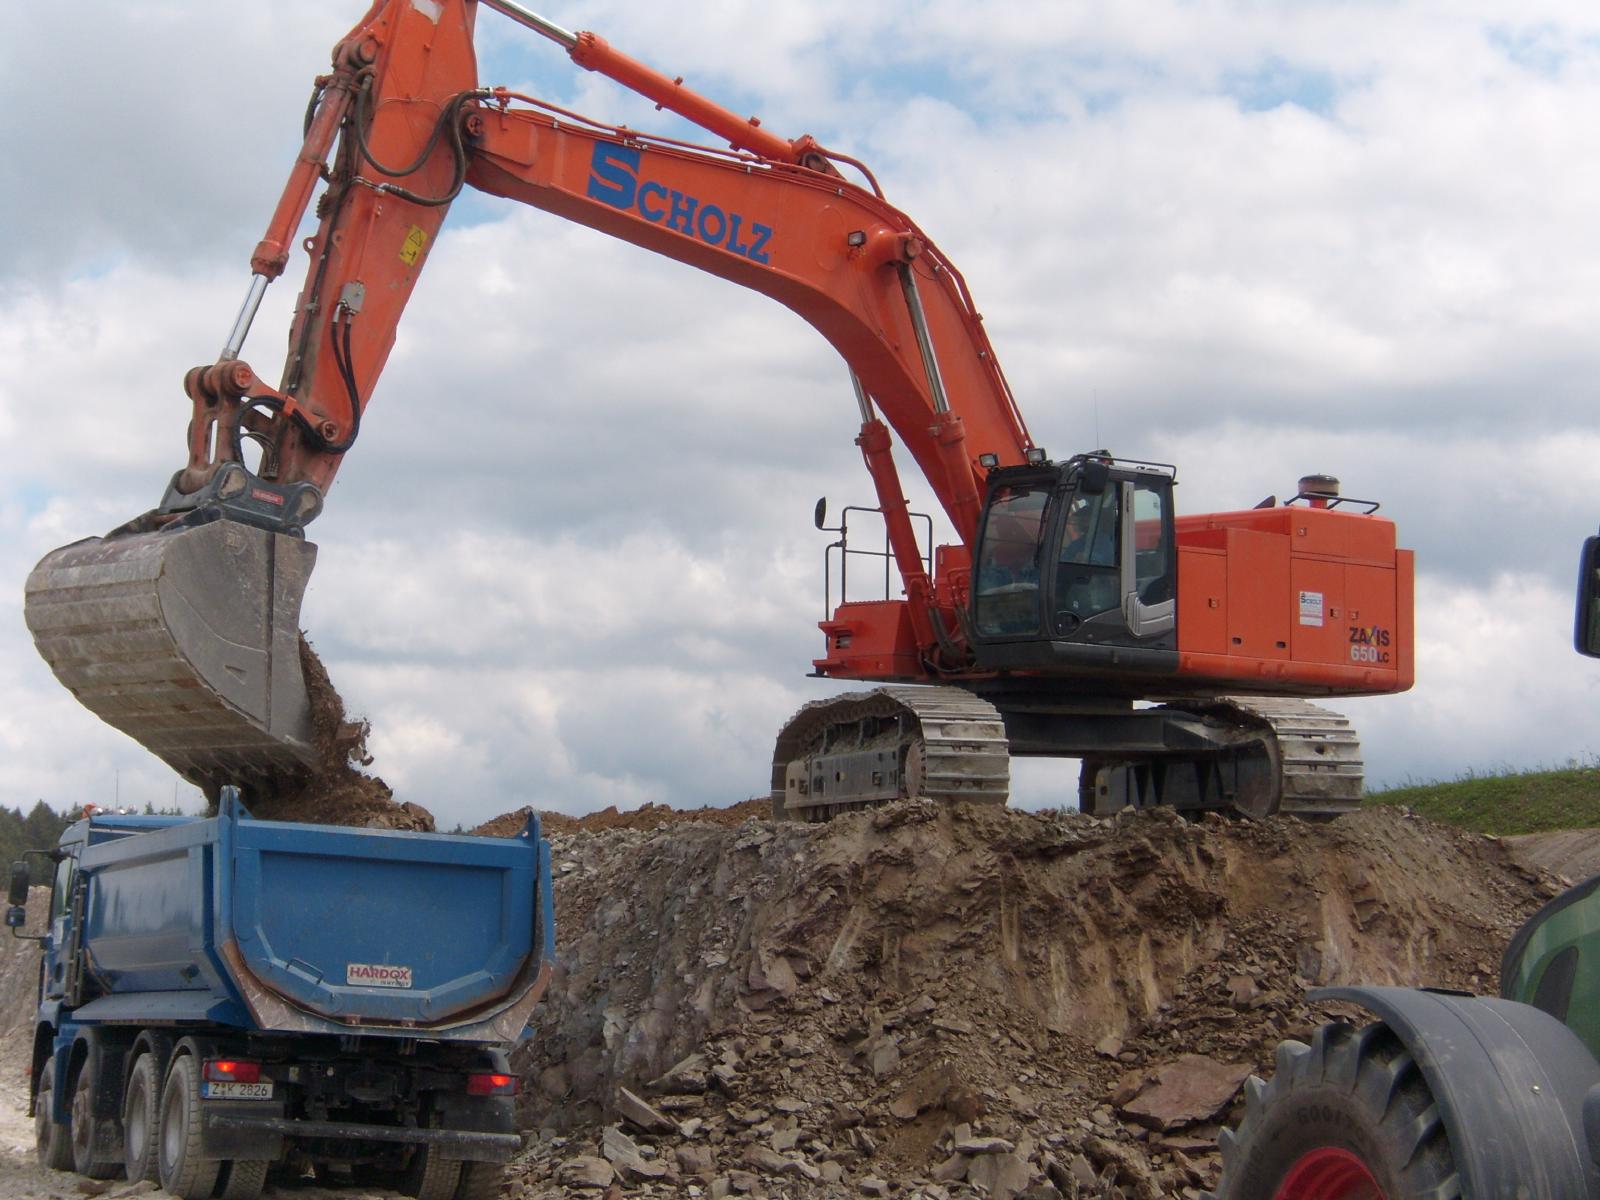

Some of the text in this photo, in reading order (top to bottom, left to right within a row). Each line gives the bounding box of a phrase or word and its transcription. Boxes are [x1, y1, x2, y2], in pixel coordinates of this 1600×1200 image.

[587, 141, 773, 264] SCHOLZ
[1349, 626, 1390, 647] ZAXIS
[350, 966, 409, 980] HARDOX
